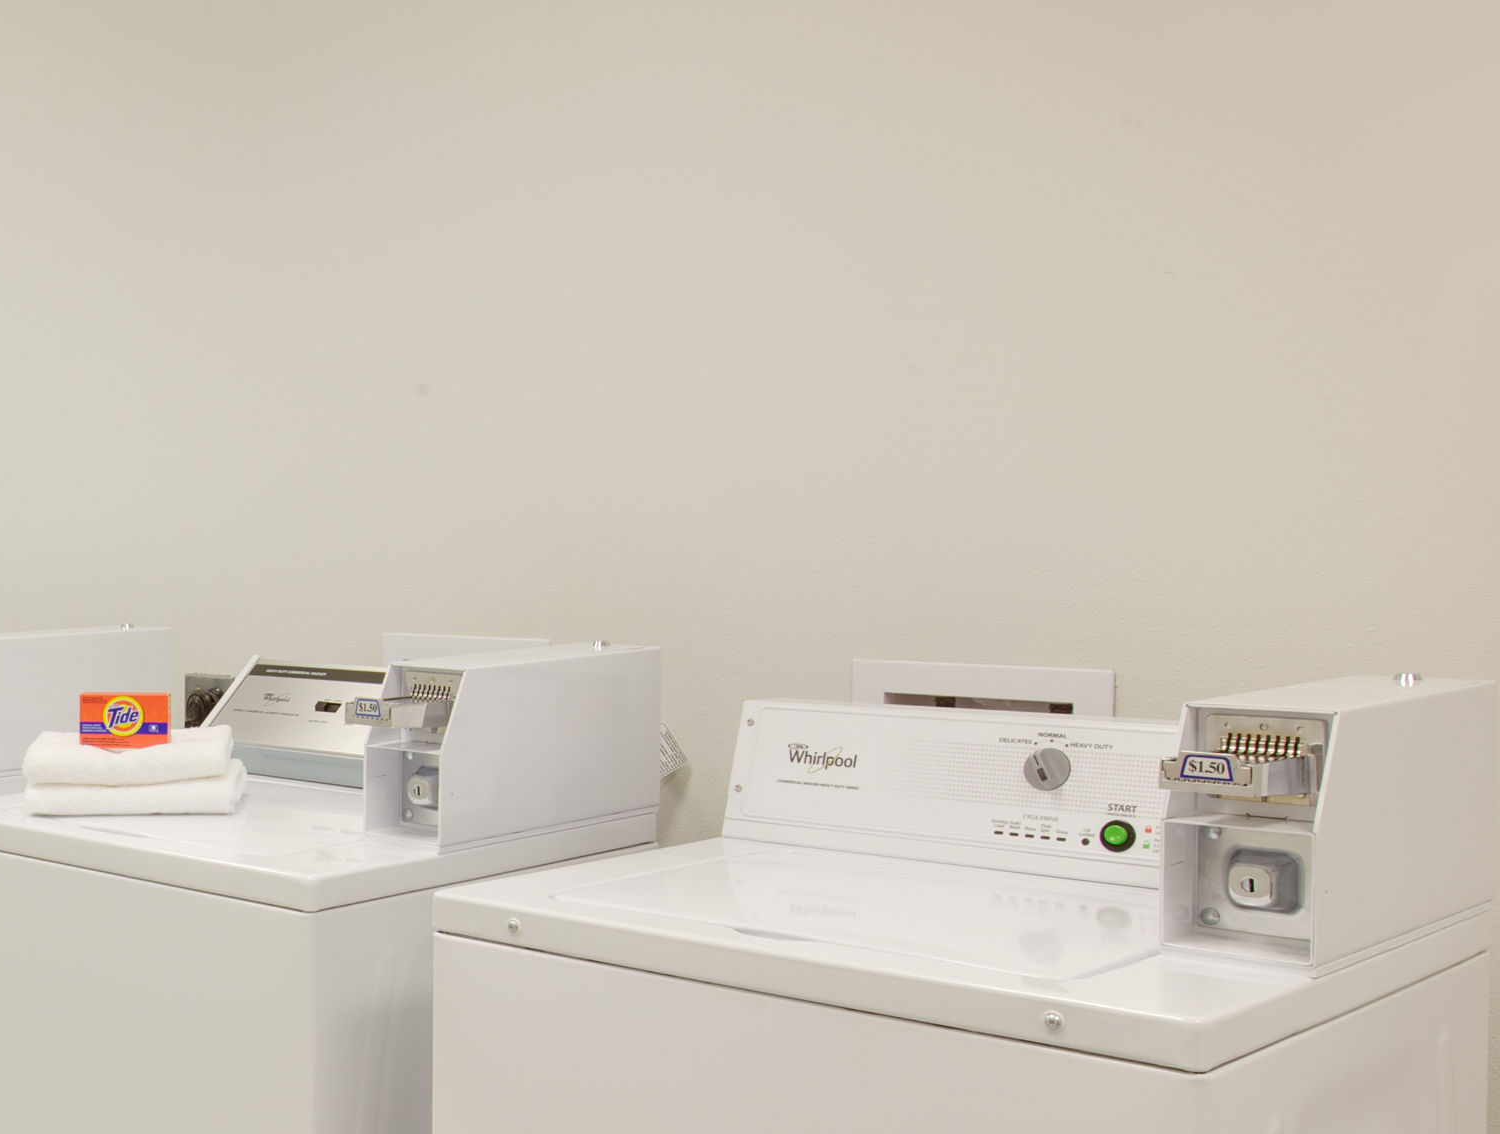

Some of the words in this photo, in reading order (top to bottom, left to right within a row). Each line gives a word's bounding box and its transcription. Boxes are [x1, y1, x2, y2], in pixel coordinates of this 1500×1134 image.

[358, 702, 378, 713] $1.50
[107, 706, 140, 730] Tide
[998, 737, 1032, 745] DELICATES
[789, 749, 858, 770] Whirlpool
[1187, 759, 1226, 775] $1.50
[1107, 803, 1138, 813] START
